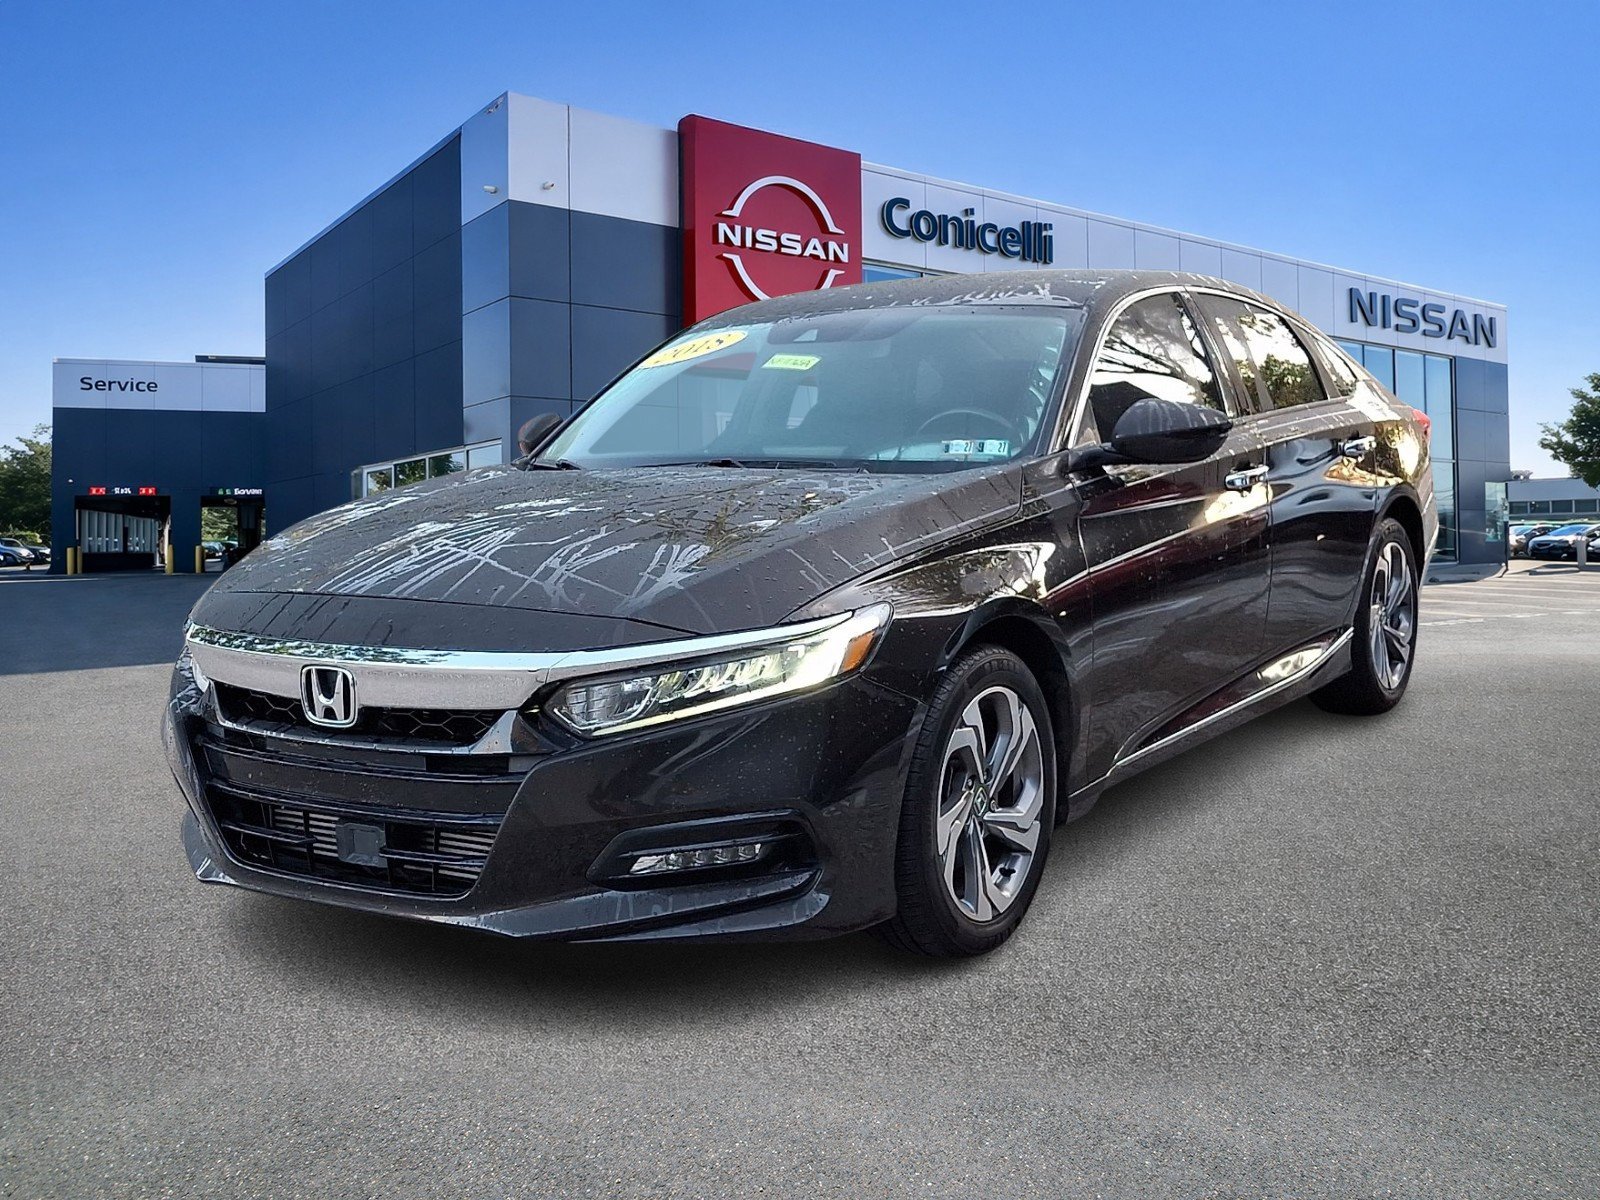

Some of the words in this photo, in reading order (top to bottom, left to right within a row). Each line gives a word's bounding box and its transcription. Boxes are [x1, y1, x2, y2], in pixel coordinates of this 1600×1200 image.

[717, 222, 849, 264] NISSAN
[881, 197, 1054, 265] Conicelli
[1349, 287, 1496, 348] NISSAN
[80, 376, 159, 392] Service
